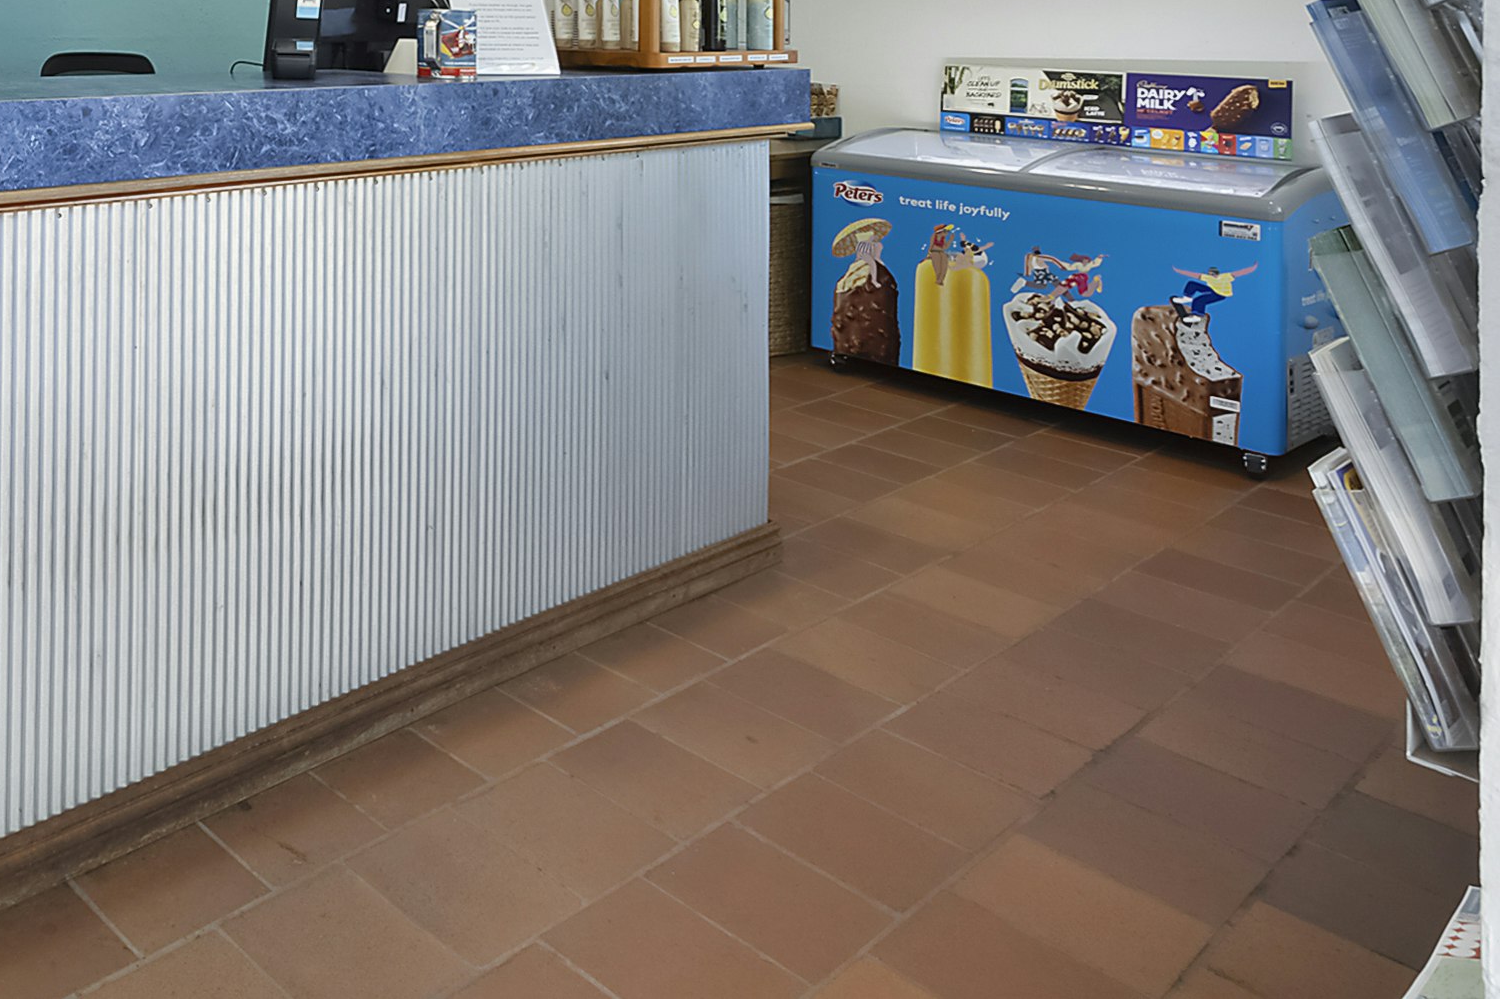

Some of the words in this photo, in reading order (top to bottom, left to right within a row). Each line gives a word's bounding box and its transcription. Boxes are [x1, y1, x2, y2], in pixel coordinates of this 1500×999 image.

[1137, 87, 1187, 100] DAIRY
[1137, 99, 1177, 110] MILK
[834, 182, 883, 203] Peters
[899, 196, 932, 209] treat
[936, 199, 956, 212] life
[959, 203, 1010, 221] joyfully
